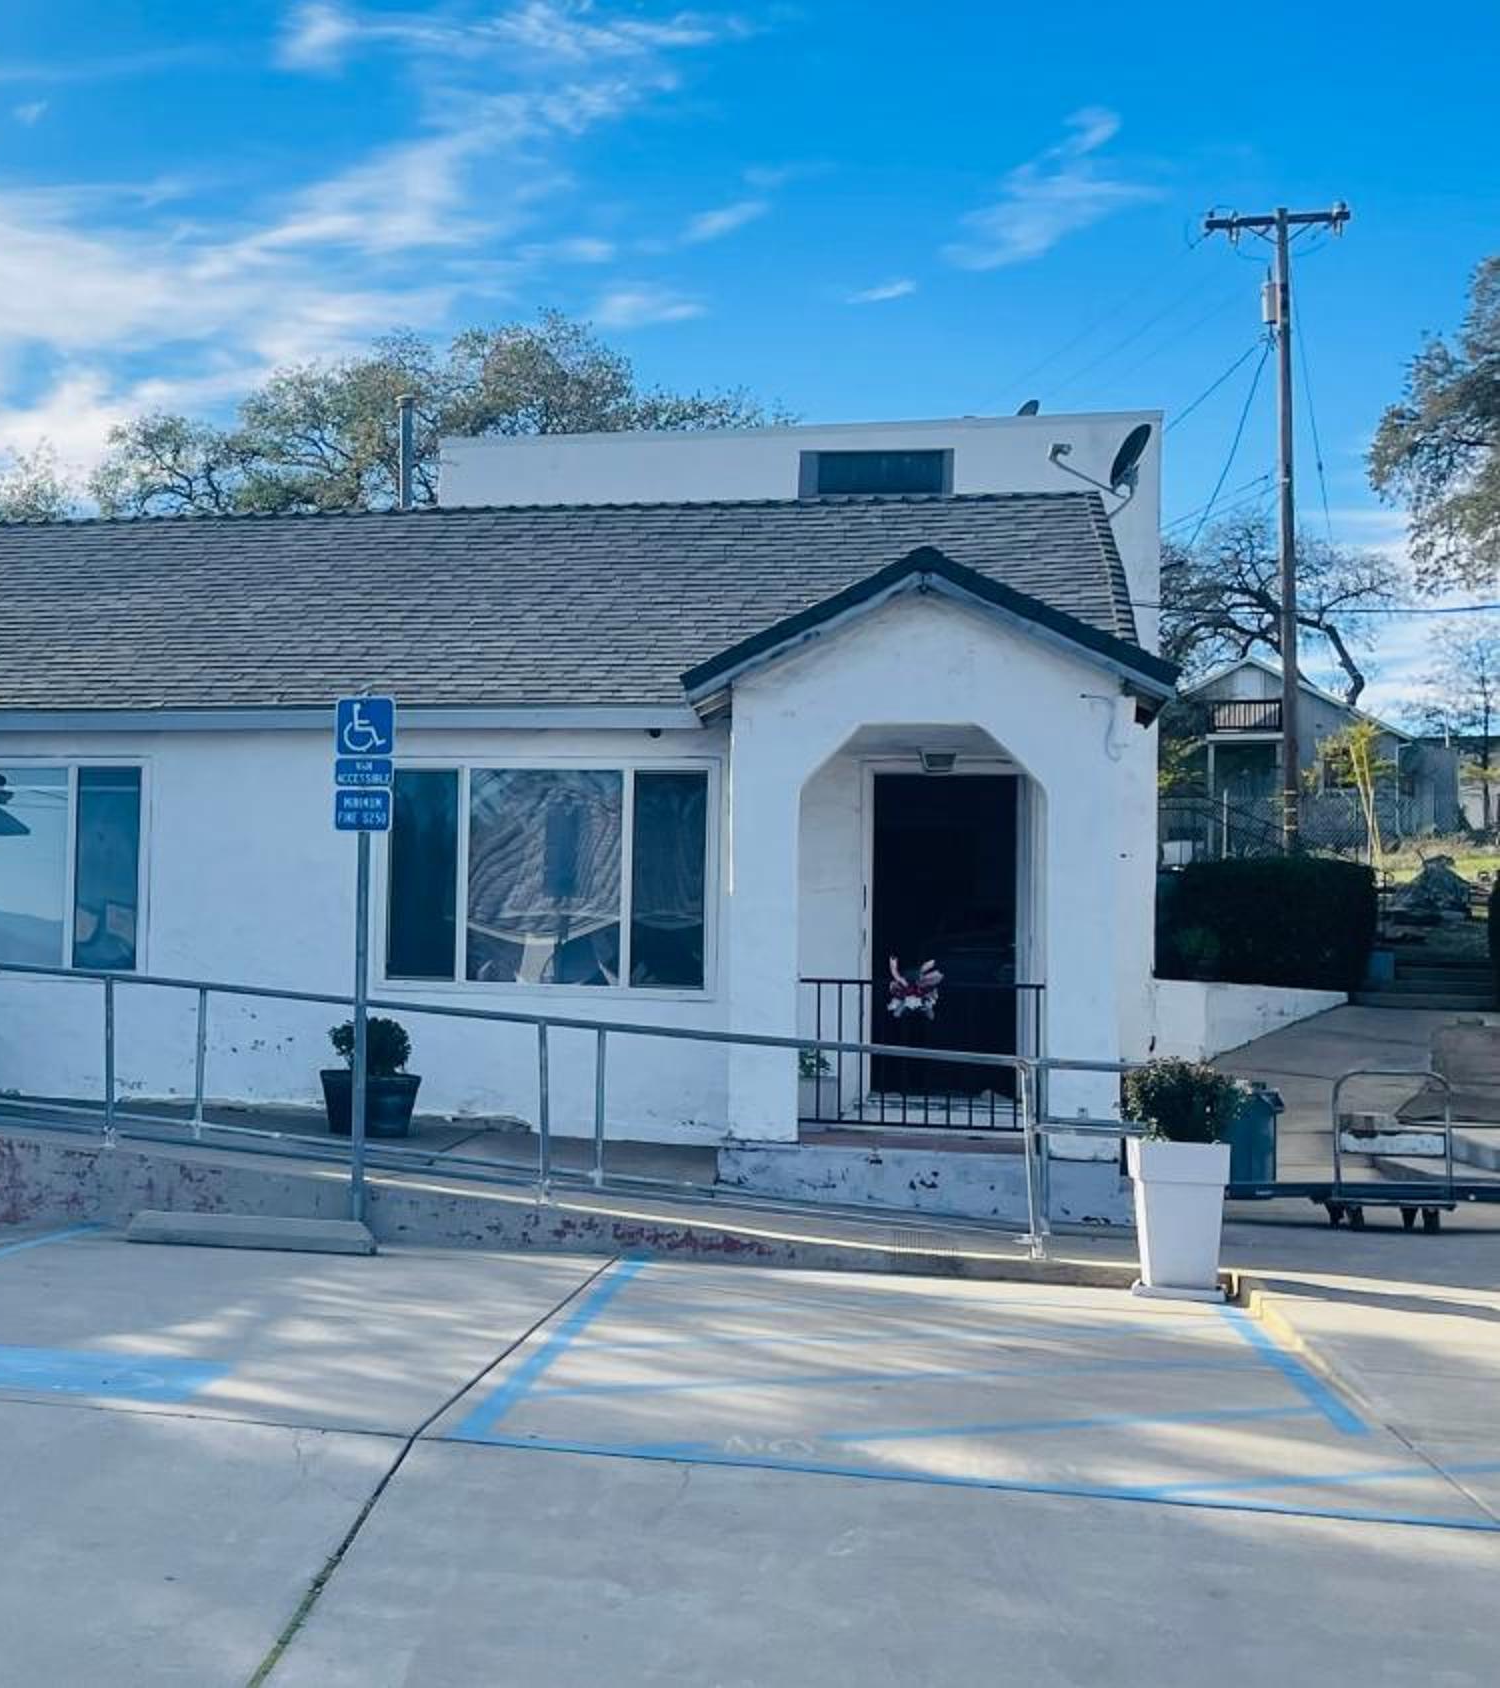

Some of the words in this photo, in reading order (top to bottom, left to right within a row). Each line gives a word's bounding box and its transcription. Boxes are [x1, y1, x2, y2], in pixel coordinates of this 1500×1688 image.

[337, 773, 390, 785] ACCESSIBLE
[343, 797, 382, 809] MINIMUM
[337, 811, 357, 825] FINE
[362, 811, 387, 825] $250
